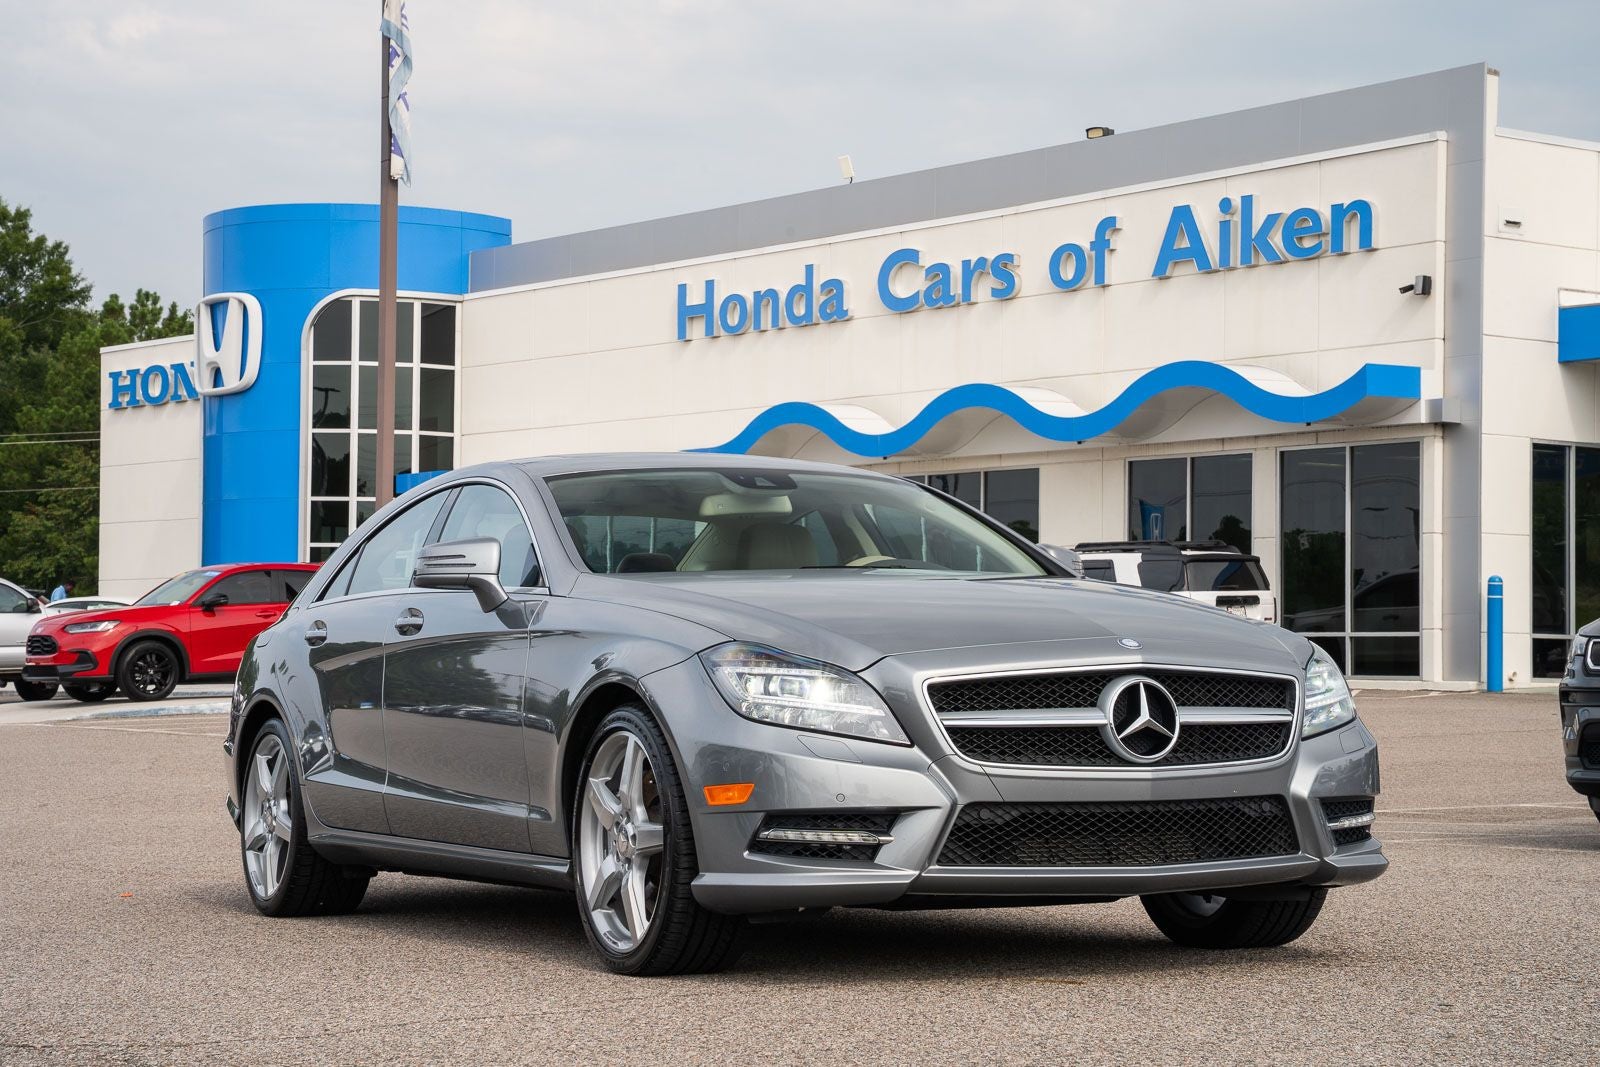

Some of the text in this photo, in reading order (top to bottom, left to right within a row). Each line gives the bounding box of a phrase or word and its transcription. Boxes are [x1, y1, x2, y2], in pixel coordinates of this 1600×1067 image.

[677, 194, 1375, 340] Honda Cars of Aiken
